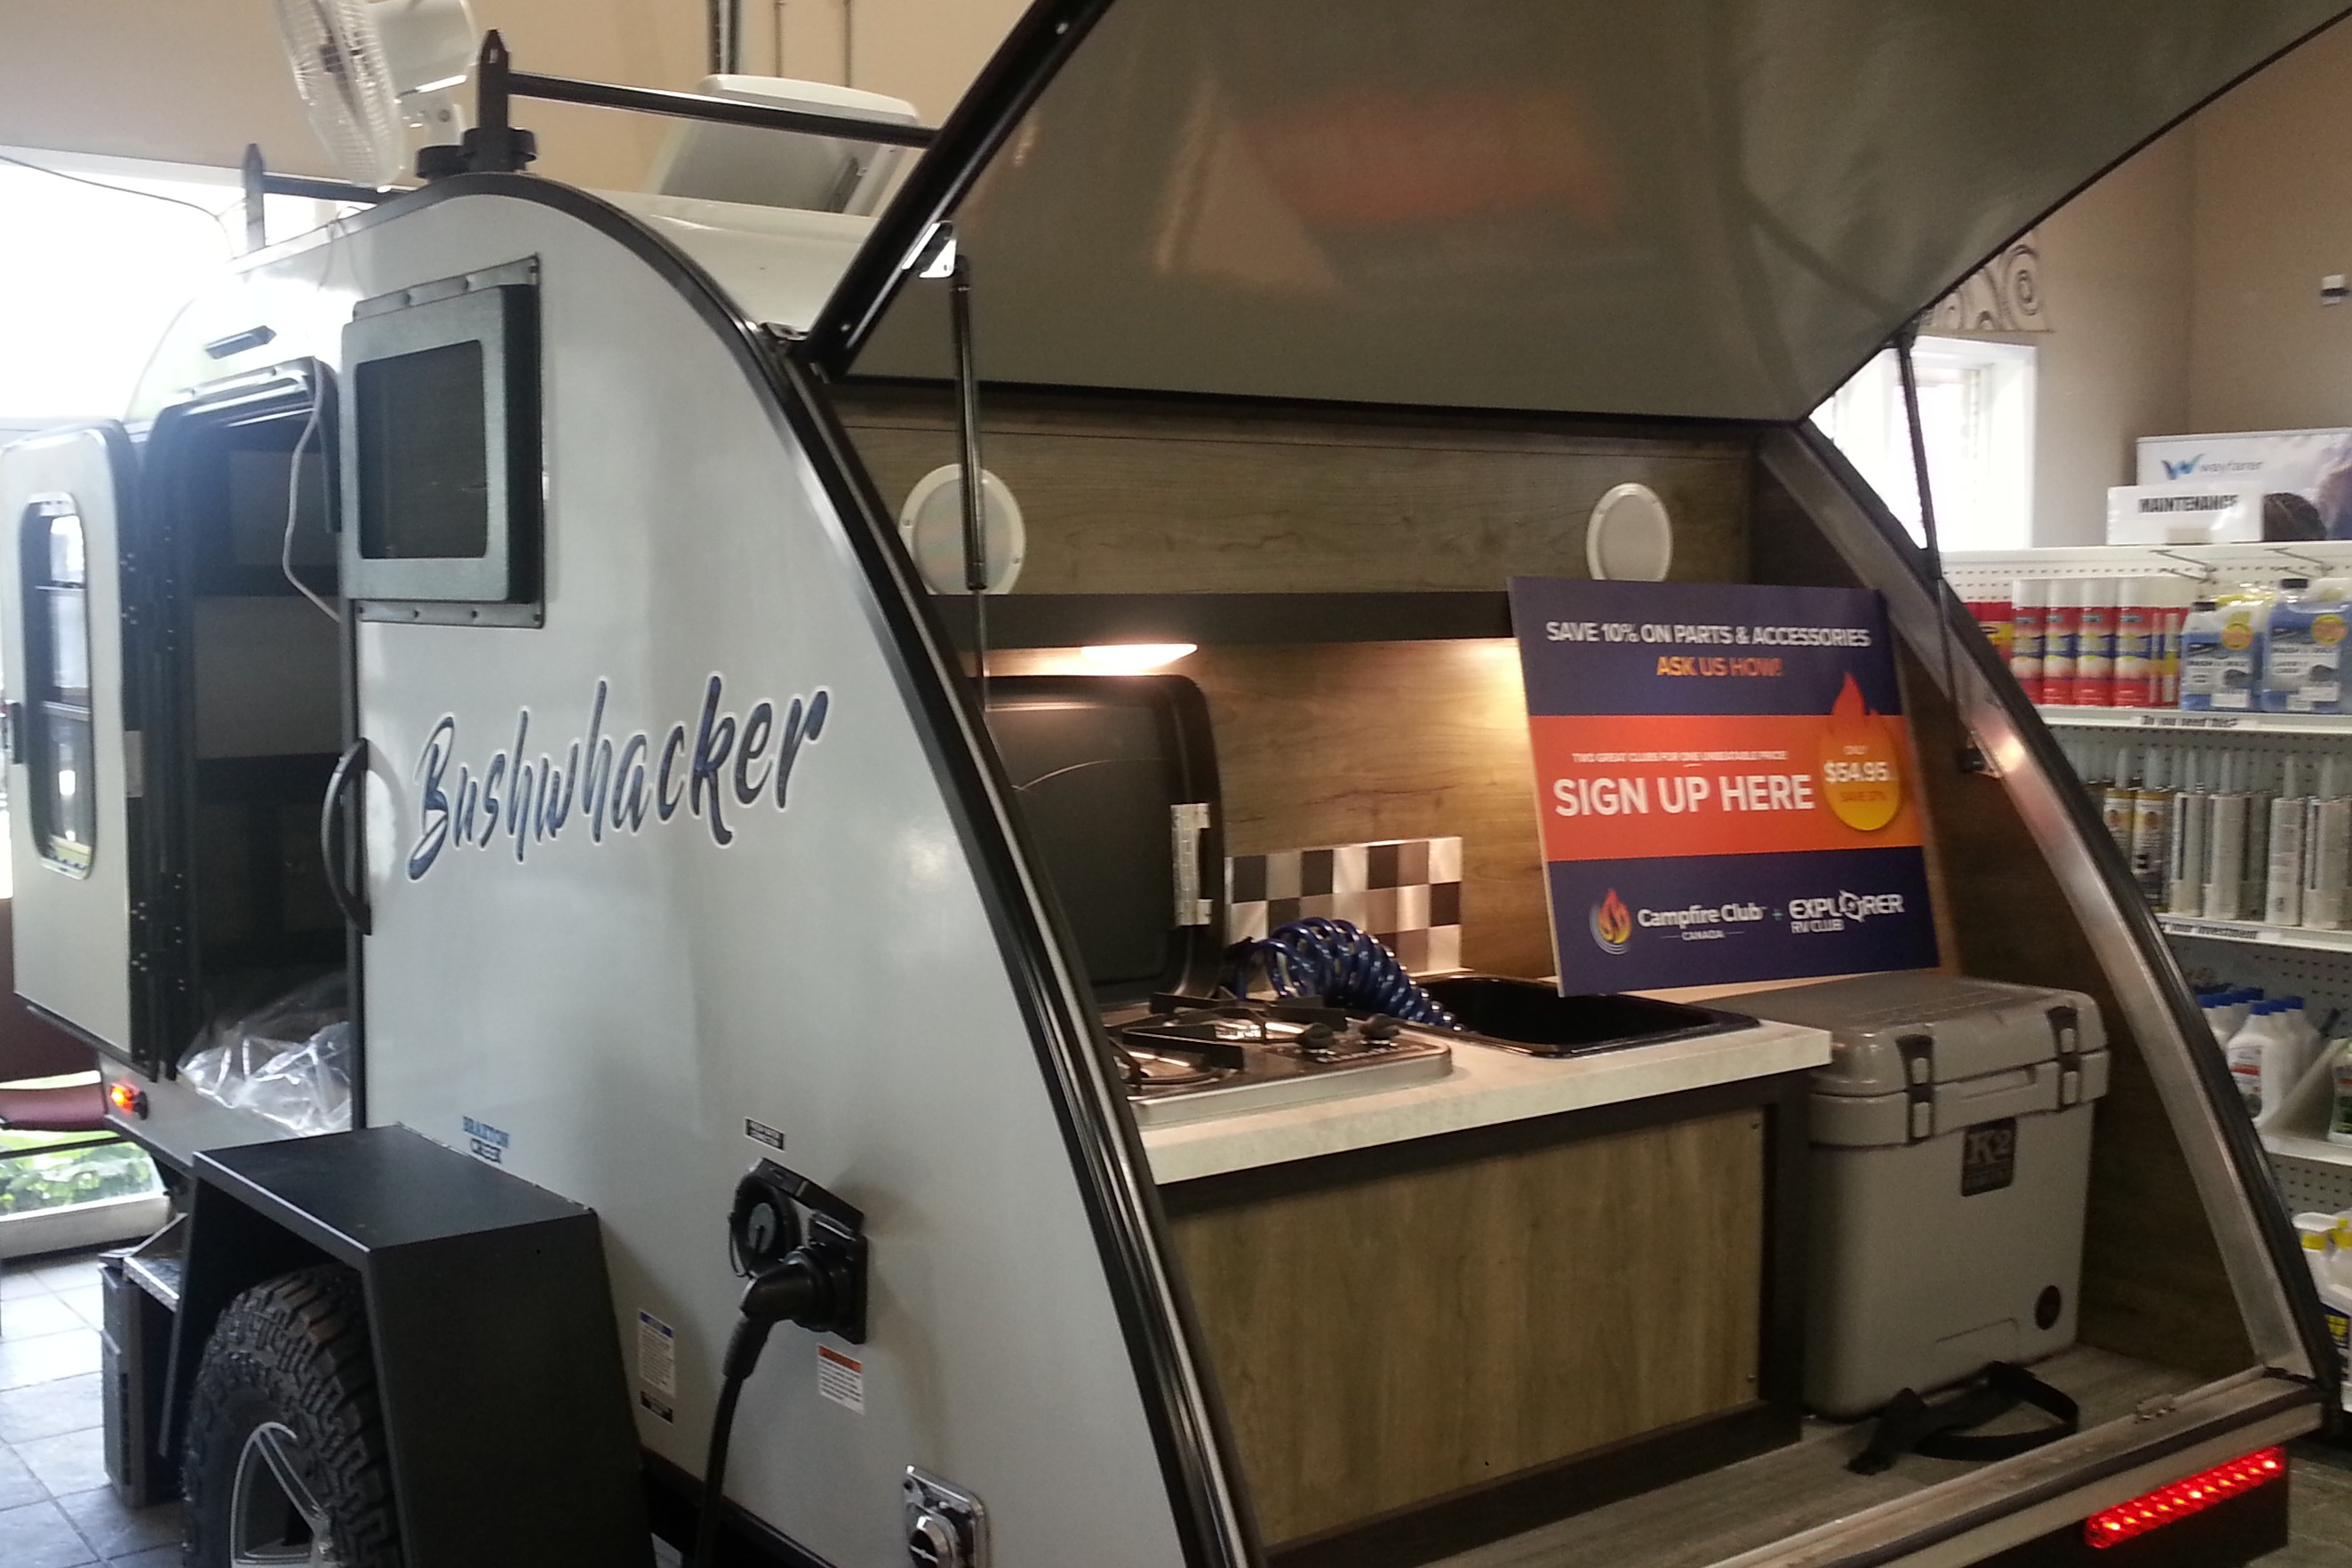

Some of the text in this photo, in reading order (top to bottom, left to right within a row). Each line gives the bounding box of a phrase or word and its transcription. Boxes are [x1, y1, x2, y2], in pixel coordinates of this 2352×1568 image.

[1545, 621, 1872, 649] SAVE 10% ON PARTS & ACCESSORIES
[1656, 656, 1697, 677] ASK
[1699, 656, 1730, 677] US
[407, 673, 830, 881] Bushwhacker
[1823, 760, 1890, 784] $54.95
[1553, 774, 1815, 816] SIGN UP HERE
[1638, 904, 1721, 929] Campfire
[1720, 902, 1764, 922] Club
[1788, 888, 1905, 923] EXPLORER
[1680, 929, 1726, 942] CANADA
[1790, 918, 1846, 934] RV CLUB
